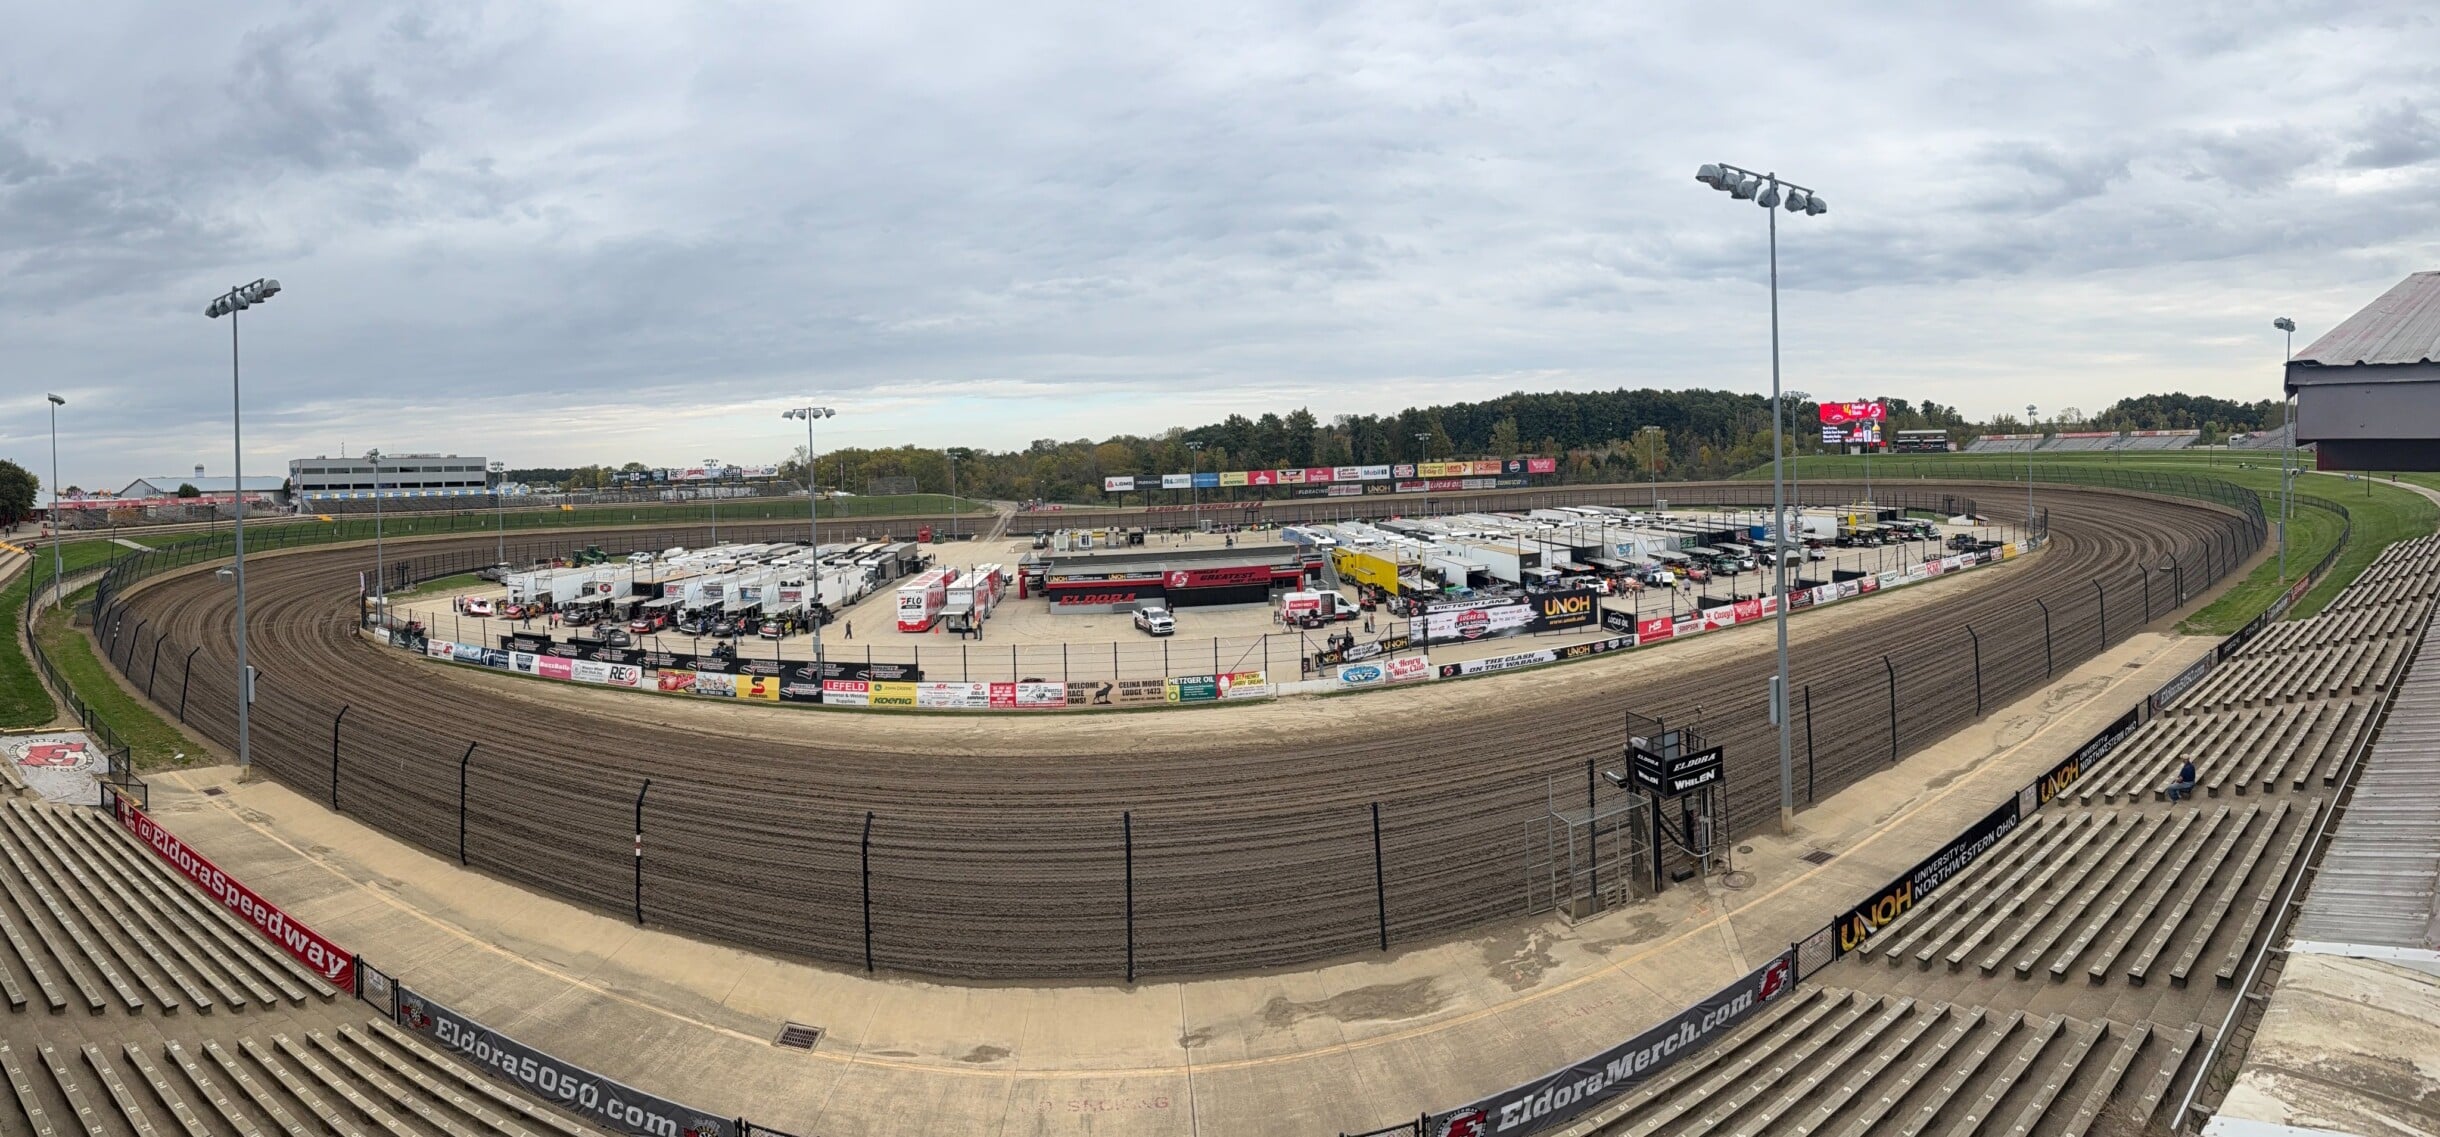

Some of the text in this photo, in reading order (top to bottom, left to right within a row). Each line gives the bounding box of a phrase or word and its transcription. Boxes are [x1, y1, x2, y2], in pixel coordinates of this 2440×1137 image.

[1058, 592, 1136, 606] ELDORA
[1434, 601, 1478, 610] VICTORY
[1544, 595, 1590, 616] UNOH
[1608, 614, 1620, 624] LUCAS
[1714, 610, 1733, 620] Casey's
[1678, 622, 1698, 633] SIMPSON
[1384, 638, 1408, 650] UNOH
[1567, 646, 1590, 658] UNOH
[1398, 656, 1420, 668] Henry
[1484, 662, 1504, 671] THE
[1506, 656, 1544, 668] WABASH
[1485, 653, 1535, 666] THE CLASH
[1410, 663, 1426, 672] Club
[826, 682, 865, 692] LEFELD
[1067, 682, 1100, 690] WELCOME
[1168, 677, 1202, 685] METZGER
[2080, 720, 2136, 773] NORTHWESTERN OHIO
[2080, 737, 2104, 760] UNIVERSITY
[1637, 754, 1659, 767] ELDORA
[1673, 752, 1716, 772] ELDORA
[2041, 758, 2078, 803] UNOH
[1914, 843, 1959, 884] UNIVERSITY
[1915, 814, 2016, 900] NORTHWESTERN OHIO
[138, 817, 348, 979] @EldoraSpeedway
[1840, 880, 1912, 951] UNOH
[1497, 986, 1753, 1133] EldoraMerch.com
[435, 1015, 678, 1137] Eldora5050.com
